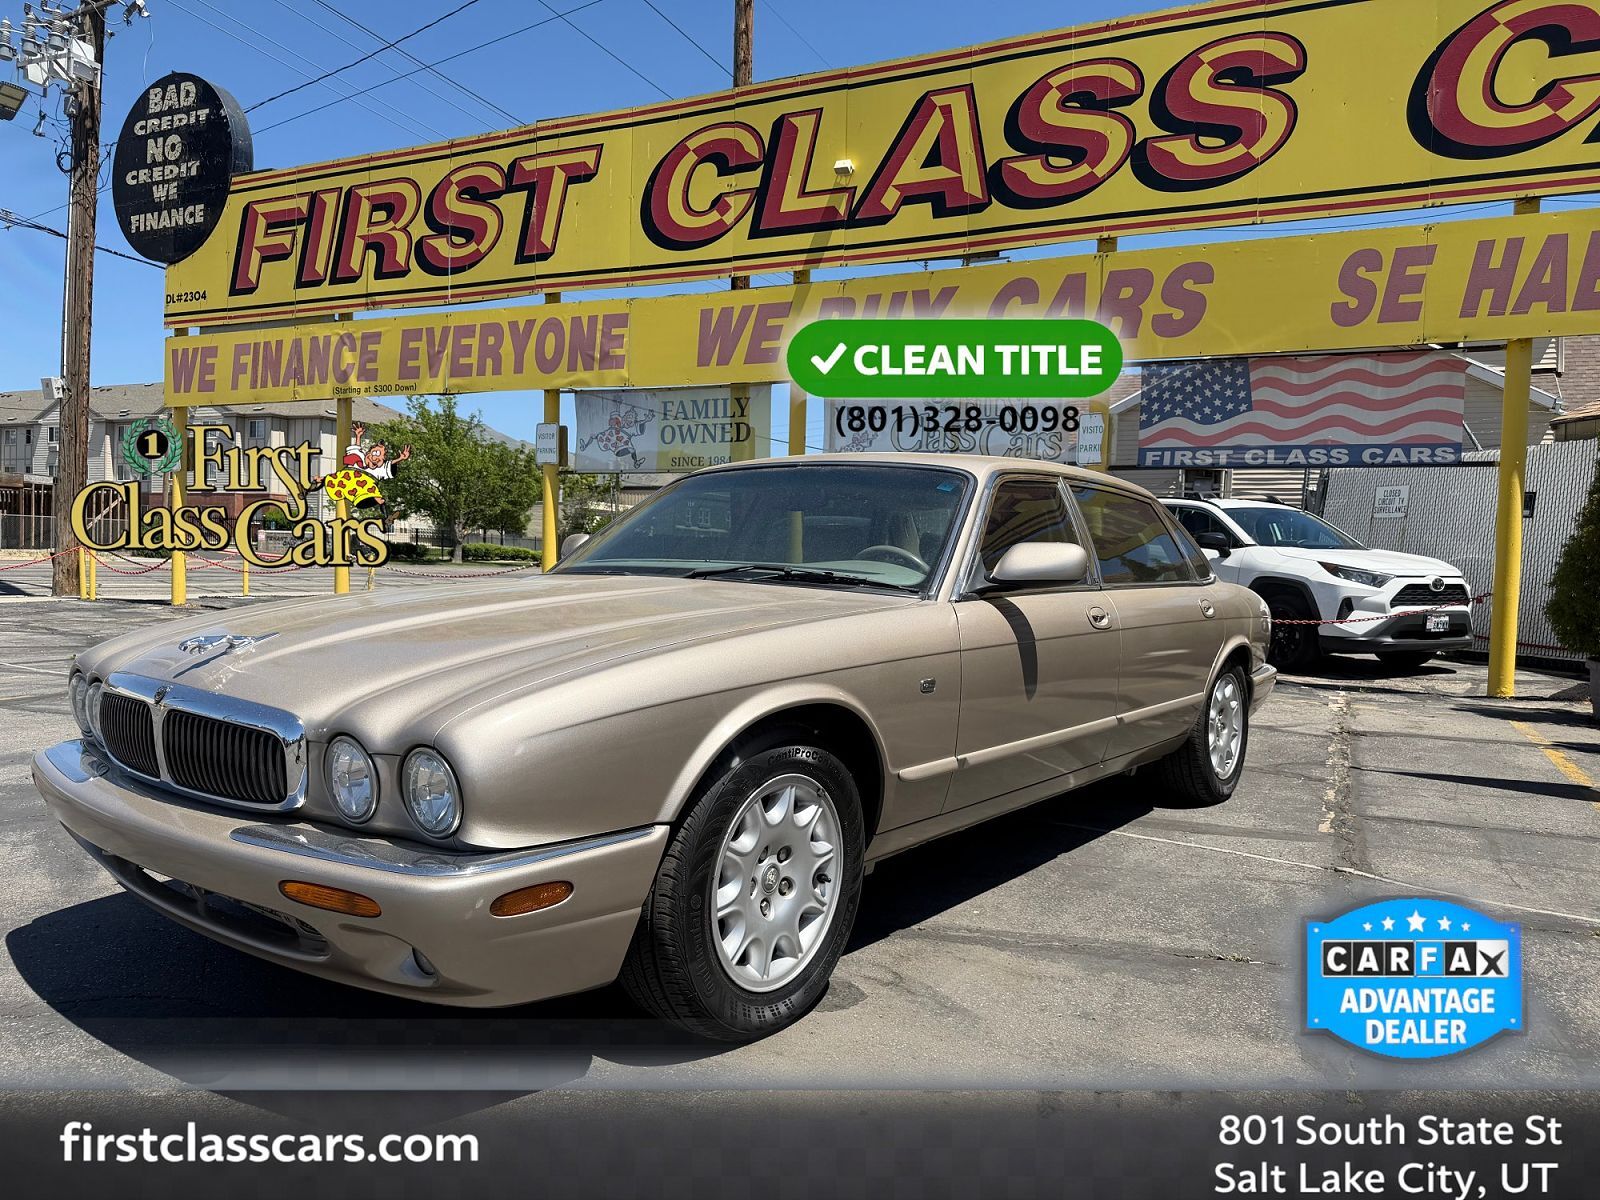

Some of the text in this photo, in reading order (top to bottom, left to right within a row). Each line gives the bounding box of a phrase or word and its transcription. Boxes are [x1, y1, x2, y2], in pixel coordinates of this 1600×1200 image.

[148, 81, 197, 114] BAD
[133, 108, 210, 136] CREDIT
[146, 134, 182, 164] NO
[229, 0, 1600, 296] FIRST CLASS C
[125, 160, 201, 186] CREDIT
[152, 181, 178, 203] WE
[130, 204, 205, 233] FINANCE
[166, 290, 207, 304] DL#2304
[1330, 244, 1438, 327] SE
[696, 301, 793, 368] WE
[172, 313, 629, 394] WE FINANCE EVERYONE
[332, 385, 361, 396] (Starting
[373, 384, 393, 393] $300
[395, 382, 417, 392] Down)
[662, 396, 751, 420] FAMILY
[660, 421, 752, 445] OWNED
[1081, 425, 1104, 435] VISITO
[671, 455, 732, 467] SINCE 1984
[1079, 444, 1101, 453] PARKI
[1145, 446, 1457, 466] FIRST CLASS CARS
